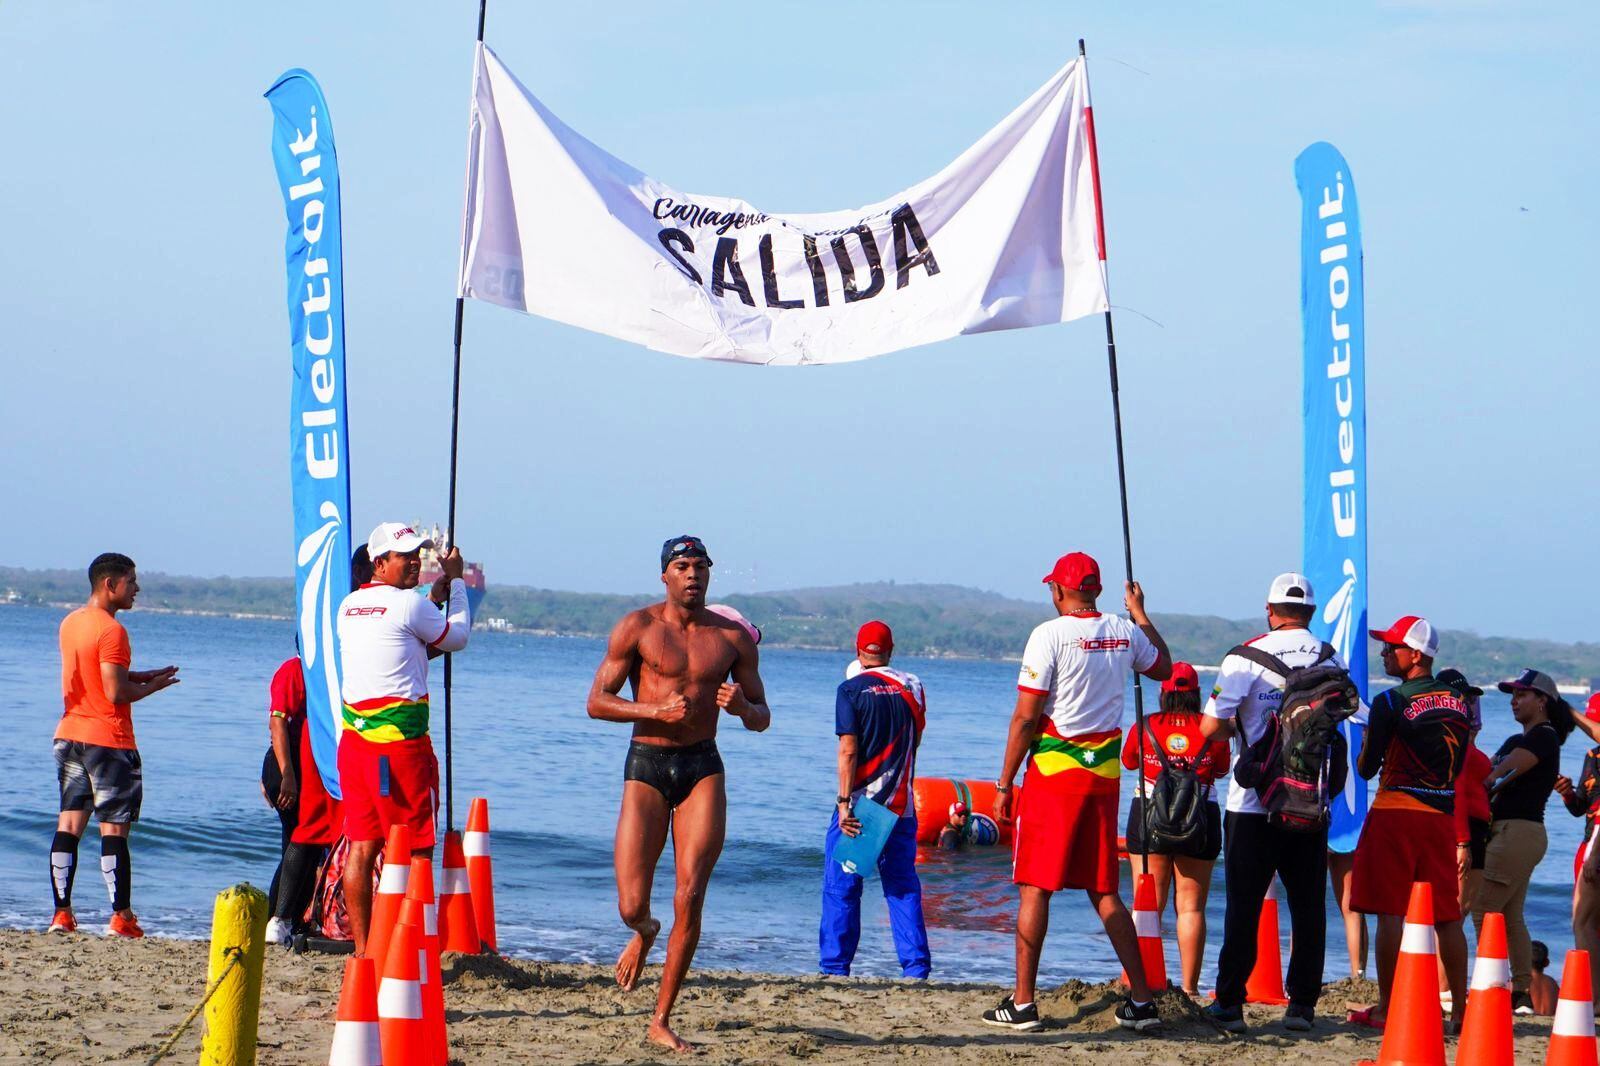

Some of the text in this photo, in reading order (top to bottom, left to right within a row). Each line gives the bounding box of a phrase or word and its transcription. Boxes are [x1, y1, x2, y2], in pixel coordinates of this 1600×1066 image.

[657, 201, 941, 310] SALIDA
[1318, 184, 1356, 538] Electrolit
[1403, 694, 1468, 721] CARTAGENA
